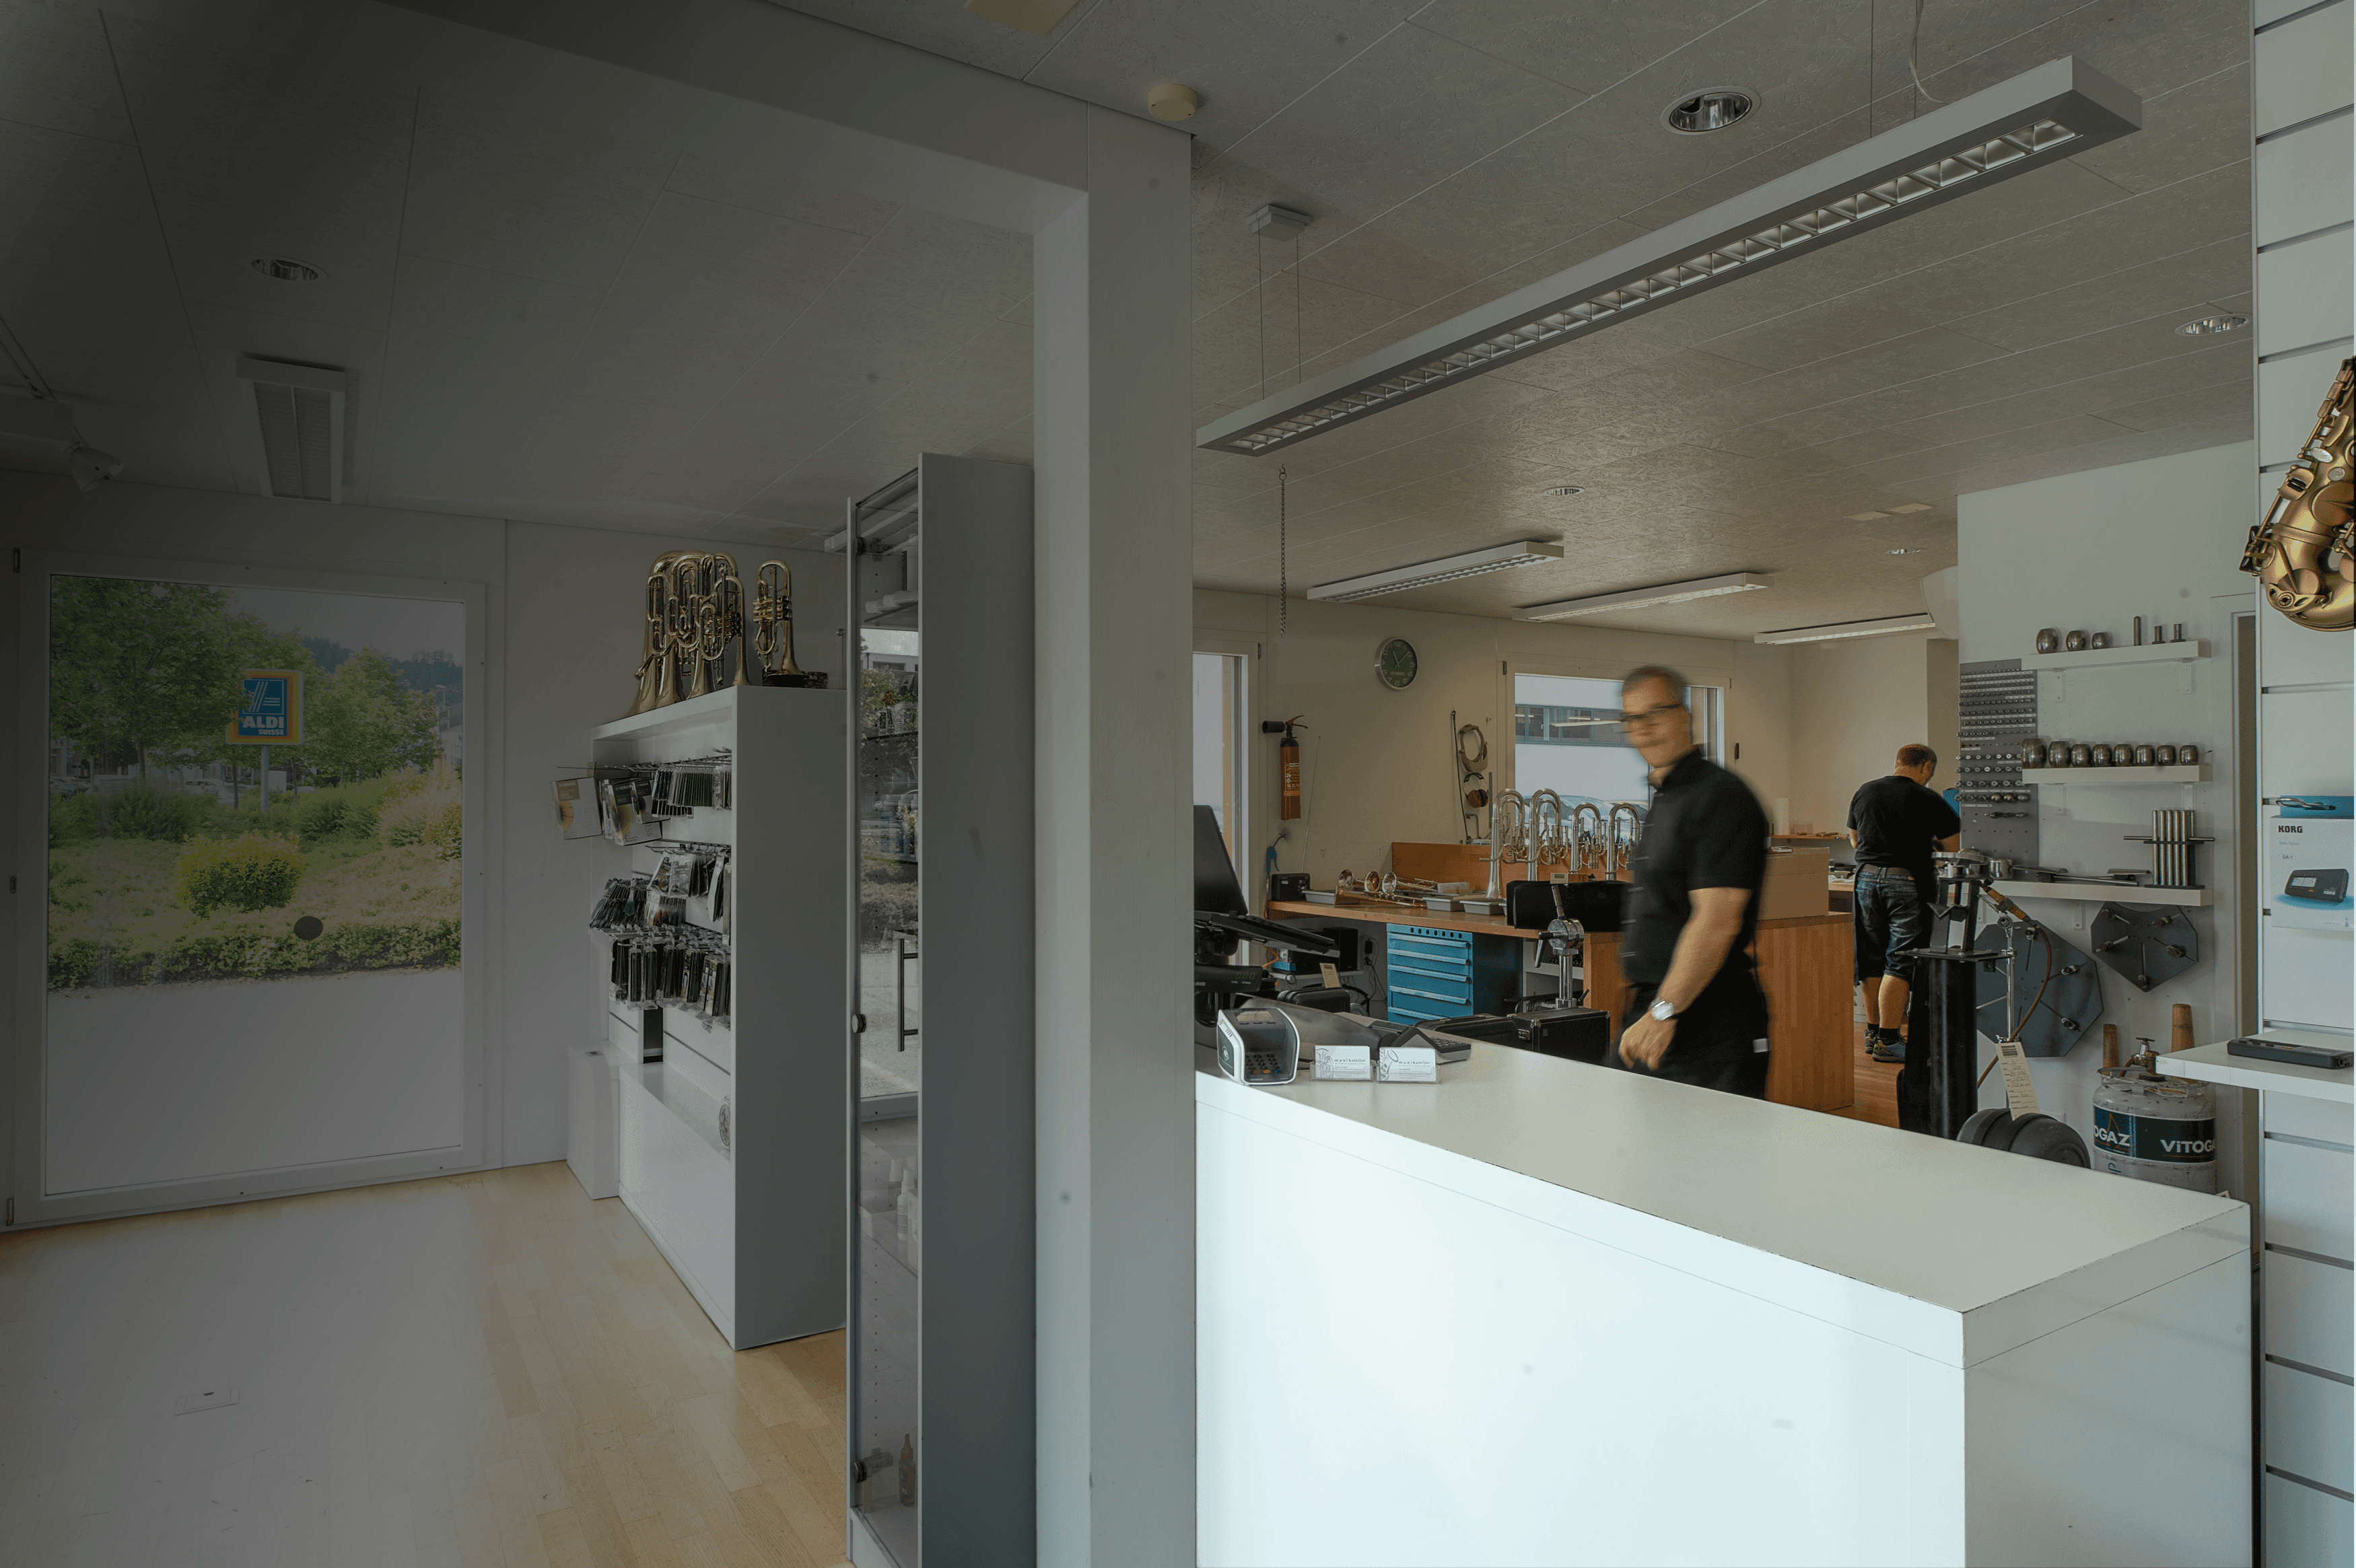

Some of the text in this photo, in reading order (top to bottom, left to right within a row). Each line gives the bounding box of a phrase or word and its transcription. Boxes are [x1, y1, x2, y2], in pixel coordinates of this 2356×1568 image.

[242, 716, 285, 729] ALDI
[584, 806, 596, 832] Brass
[2278, 825, 2303, 833] KORG
